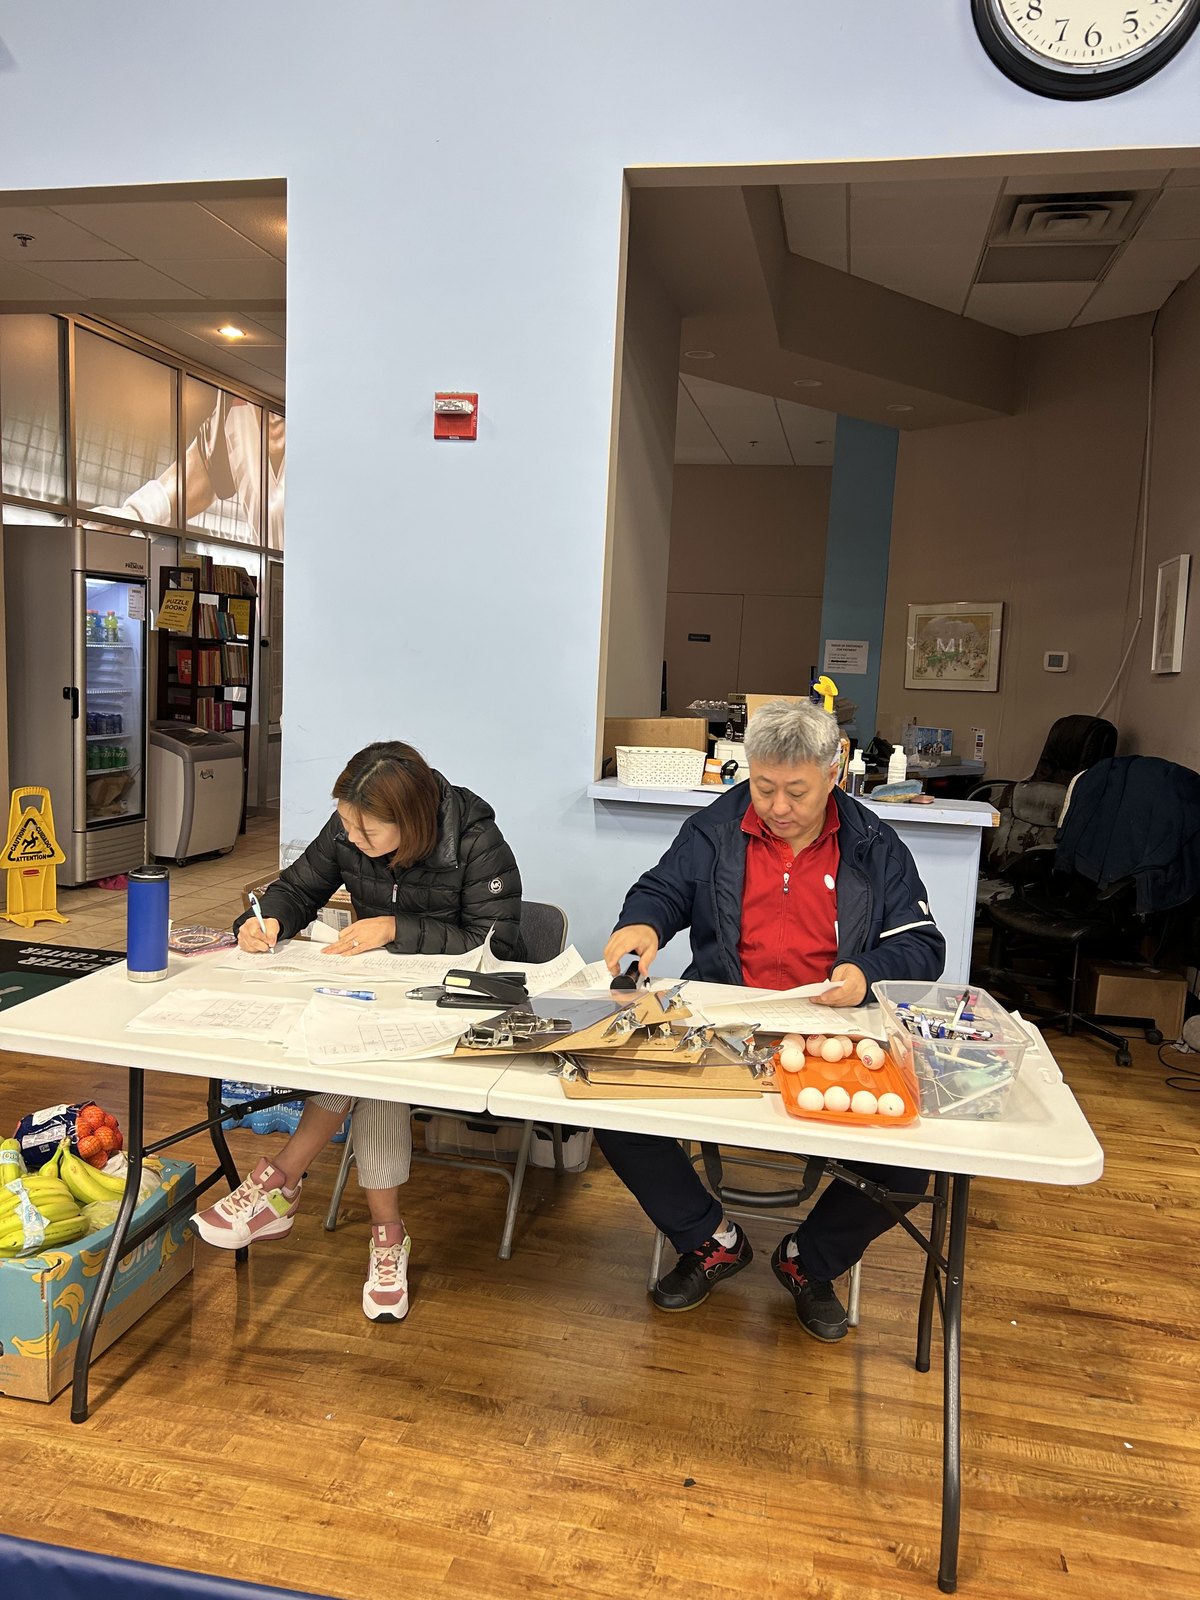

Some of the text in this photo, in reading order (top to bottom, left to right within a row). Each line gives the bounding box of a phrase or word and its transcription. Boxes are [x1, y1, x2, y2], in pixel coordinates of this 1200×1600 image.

[1026, 0, 1043, 21] 8
[1055, 18, 1070, 42] 7
[1122, 9, 1139, 34] 5
[1084, 22, 1103, 48] 6
[165, 604, 188, 612] BOOKS
[166, 598, 190, 606] PUZZLE
[10, 827, 26, 851] CAUTION
[36, 826, 52, 849] CUIDADO
[16, 854, 47, 862] ATTENTION
[18, 956, 108, 972] ESTER
[19, 947, 99, 960] CENTER
